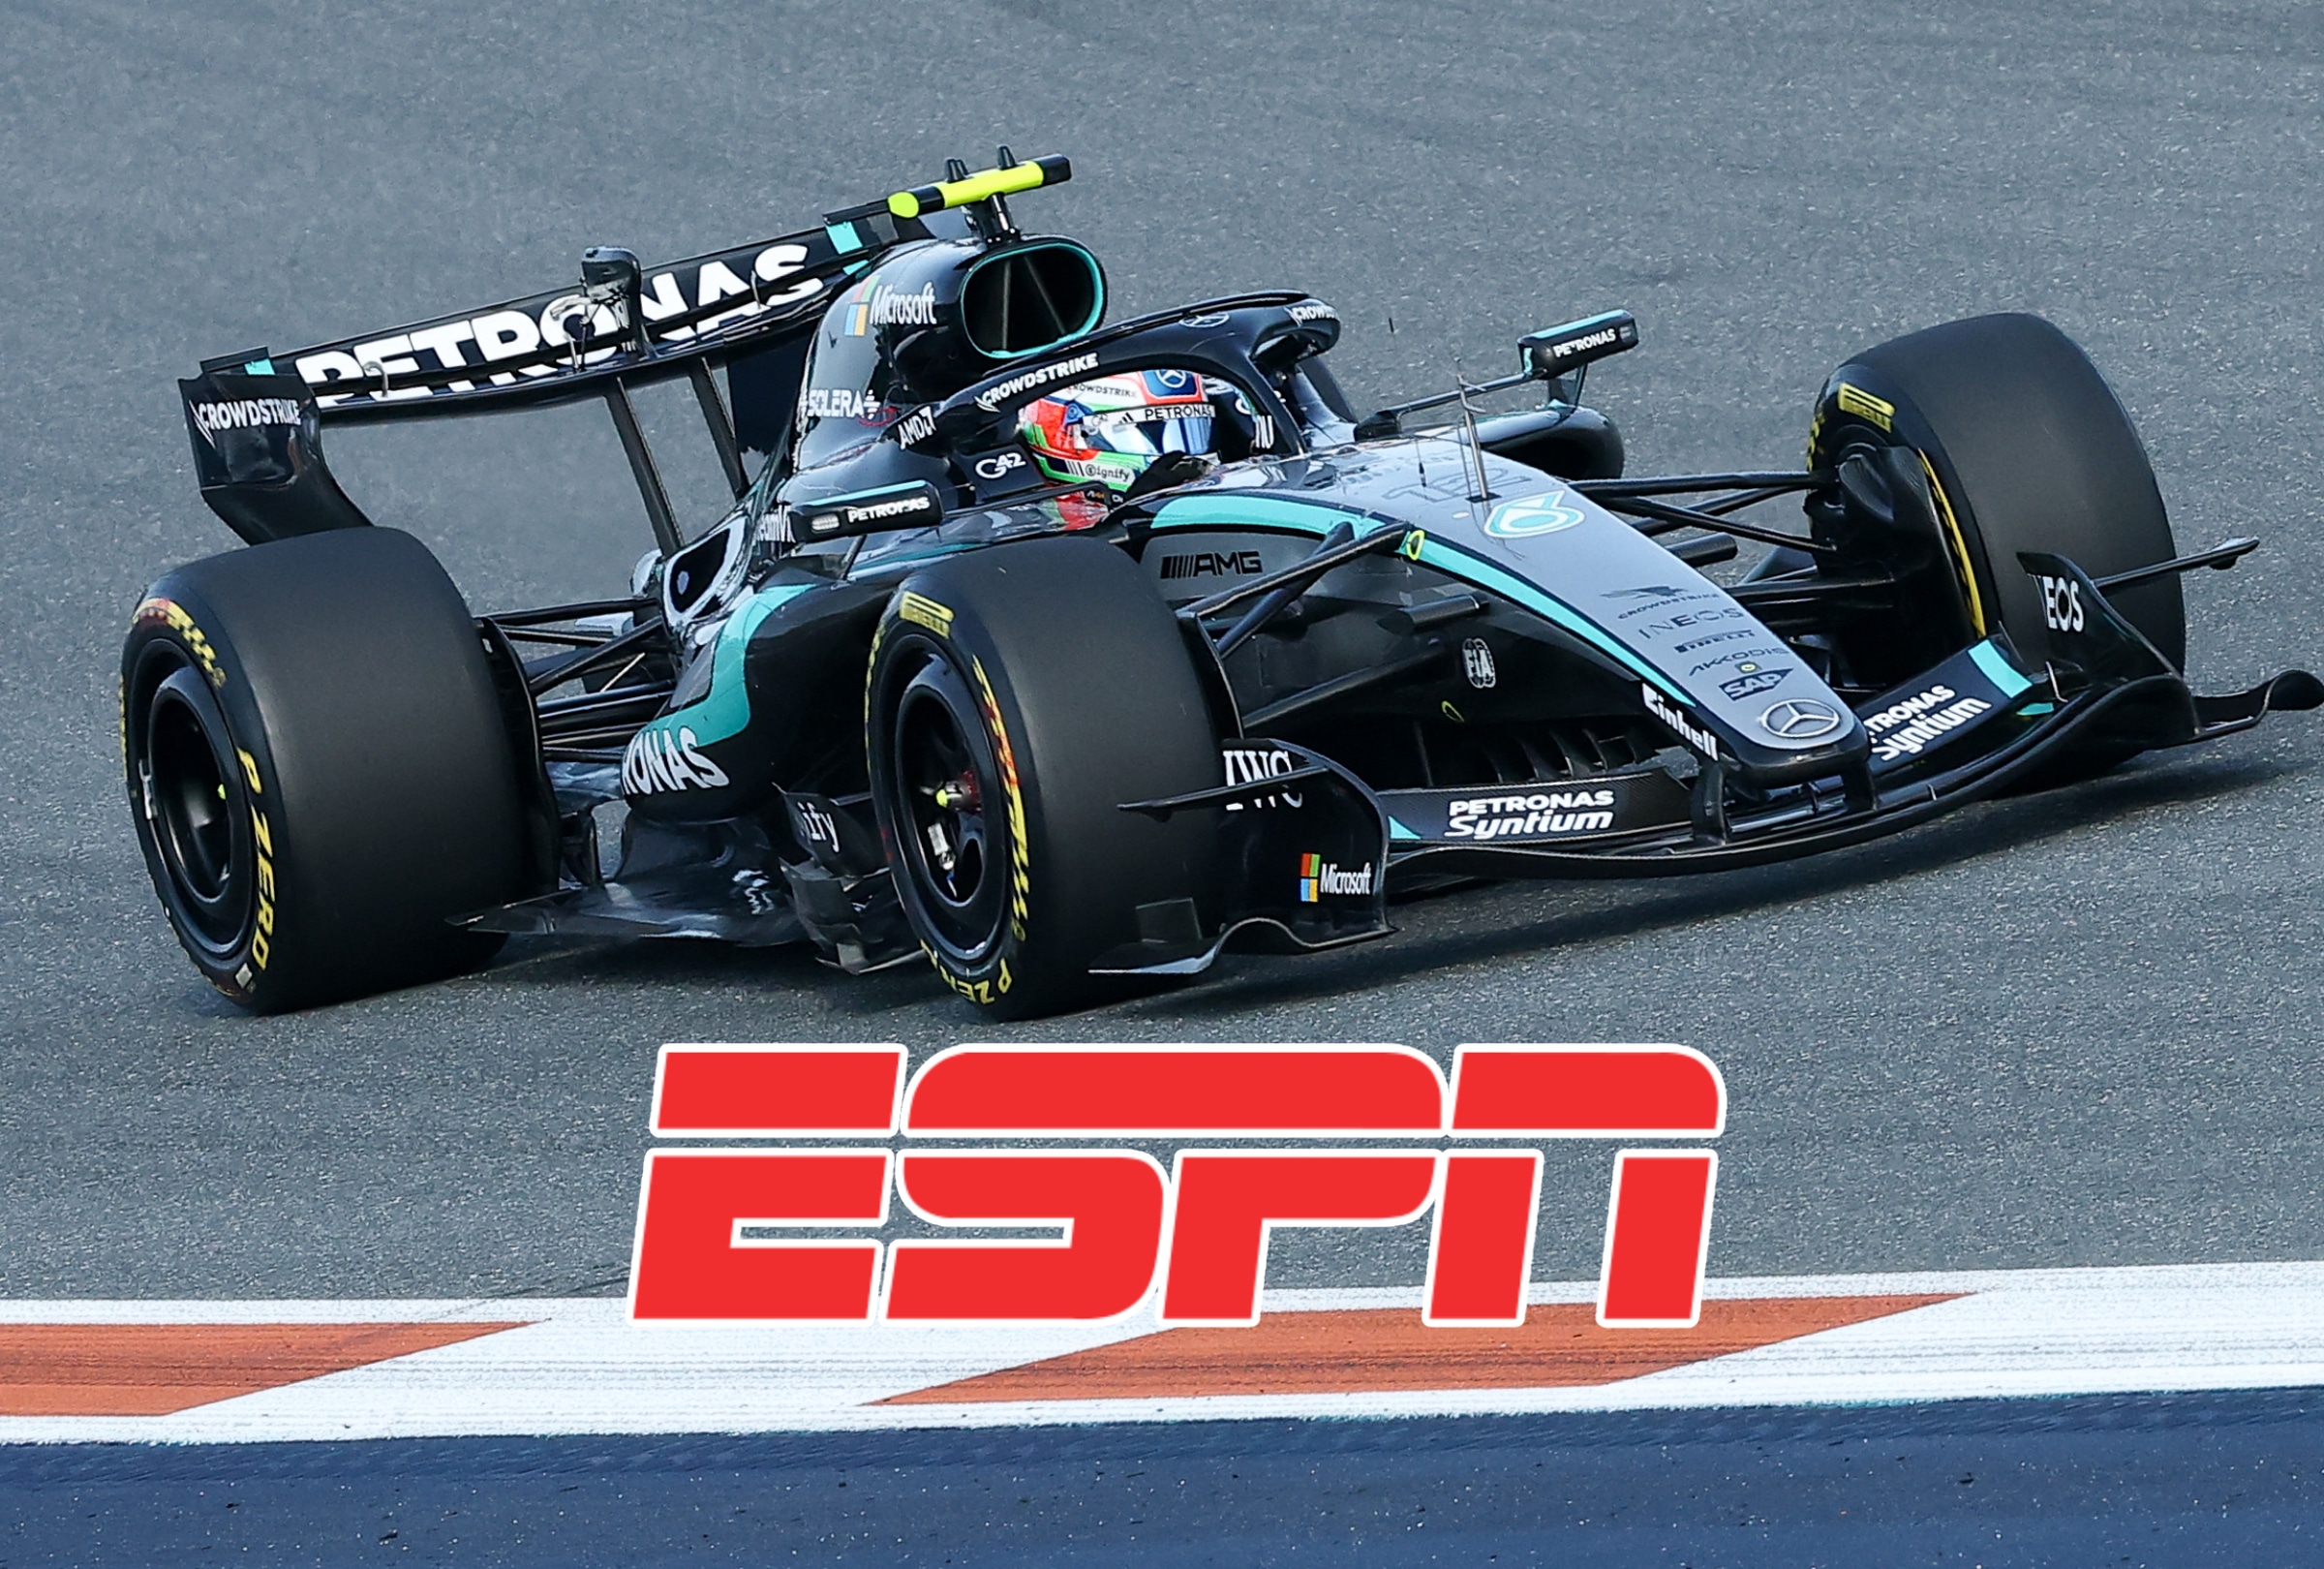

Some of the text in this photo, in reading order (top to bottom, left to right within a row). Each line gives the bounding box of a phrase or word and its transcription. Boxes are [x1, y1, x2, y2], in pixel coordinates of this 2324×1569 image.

[870, 282, 937, 325] Microsoft
[294, 242, 826, 409] PETRONAS
[1552, 327, 1617, 358] PETRONAS
[981, 352, 1099, 407] CROWDSTRIKE
[198, 397, 302, 431] CROWDSTRIKE
[807, 388, 865, 418] SOLERA
[1144, 403, 1212, 420] PETRONAS
[897, 415, 925, 450] AMD
[974, 452, 1026, 479] G42
[847, 496, 931, 524] PETRONAS
[1193, 550, 1263, 578] AMG
[1637, 607, 1745, 640] INEOS
[1463, 648, 1495, 678] FIA
[1722, 671, 1783, 698] SAP
[1641, 682, 1719, 761] Einhell
[1449, 789, 1615, 816] PETRONAS
[1444, 810, 1615, 841] Syntium
[251, 804, 276, 970] ZERO
[1319, 862, 1372, 896] Microsoft
